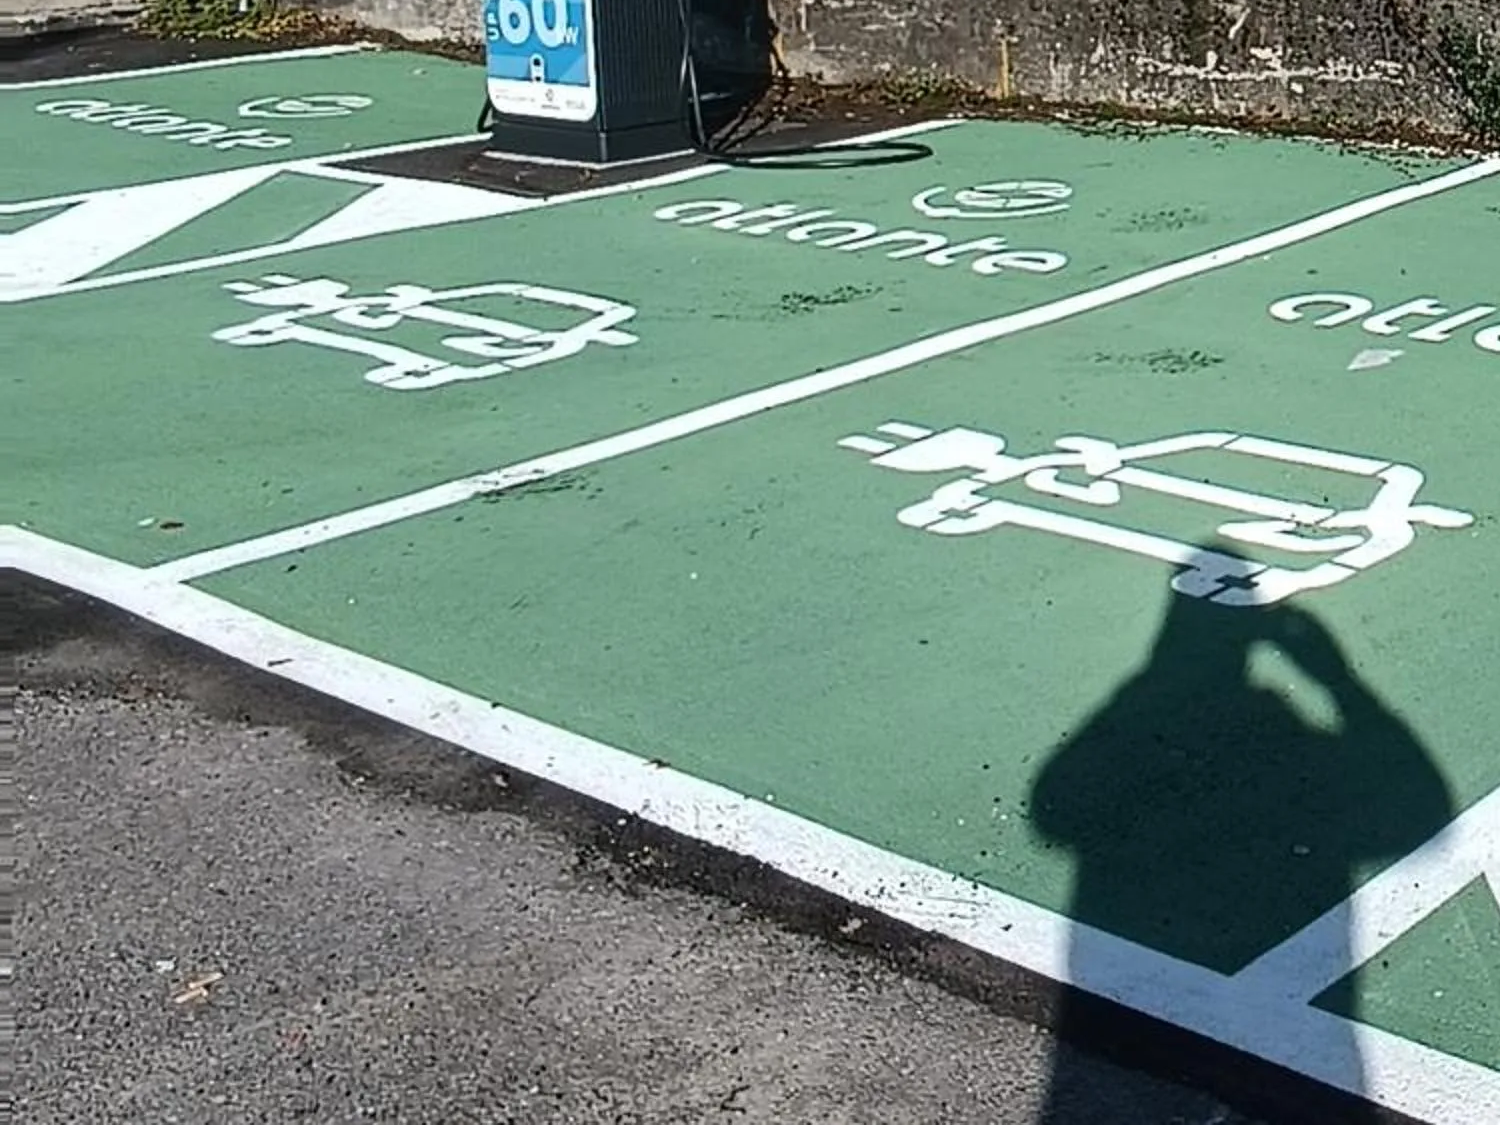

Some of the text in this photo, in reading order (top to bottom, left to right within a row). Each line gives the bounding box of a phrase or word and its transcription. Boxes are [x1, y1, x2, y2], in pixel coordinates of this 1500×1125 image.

[486, 11, 500, 42] UP
[35, 98, 293, 150] atlante
[653, 198, 1069, 276] atlante
